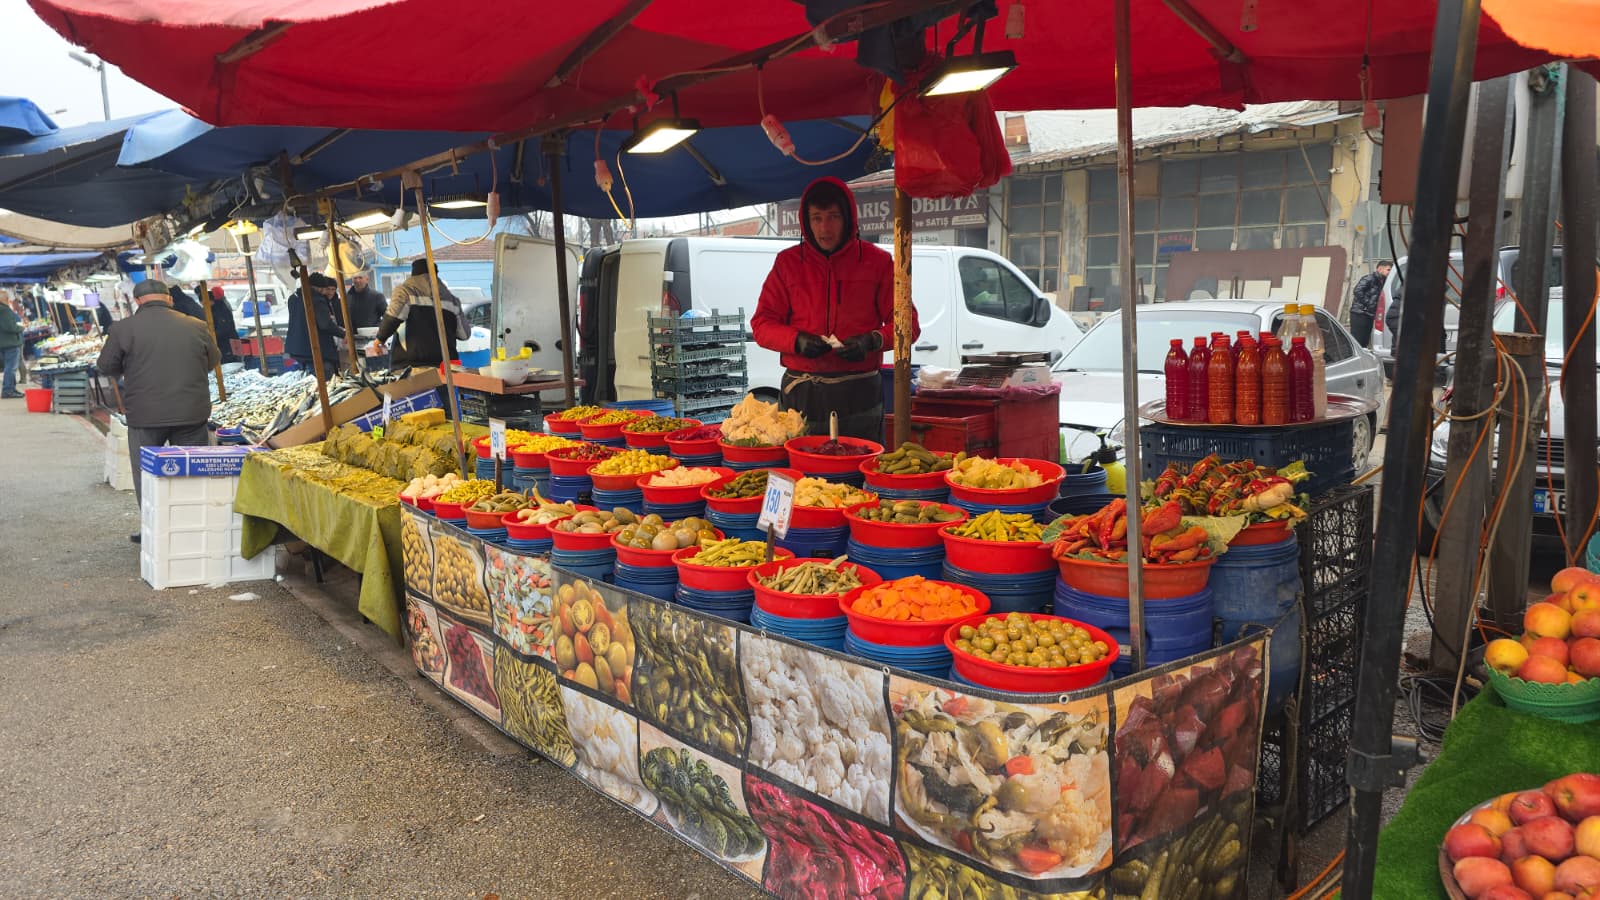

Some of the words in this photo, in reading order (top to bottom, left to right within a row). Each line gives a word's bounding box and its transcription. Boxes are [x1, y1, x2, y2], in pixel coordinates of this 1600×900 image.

[911, 194, 978, 214] OBİLYA
[862, 220, 885, 231] YATAK
[926, 216, 949, 227] SATIŞ
[766, 487, 781, 514] 150
